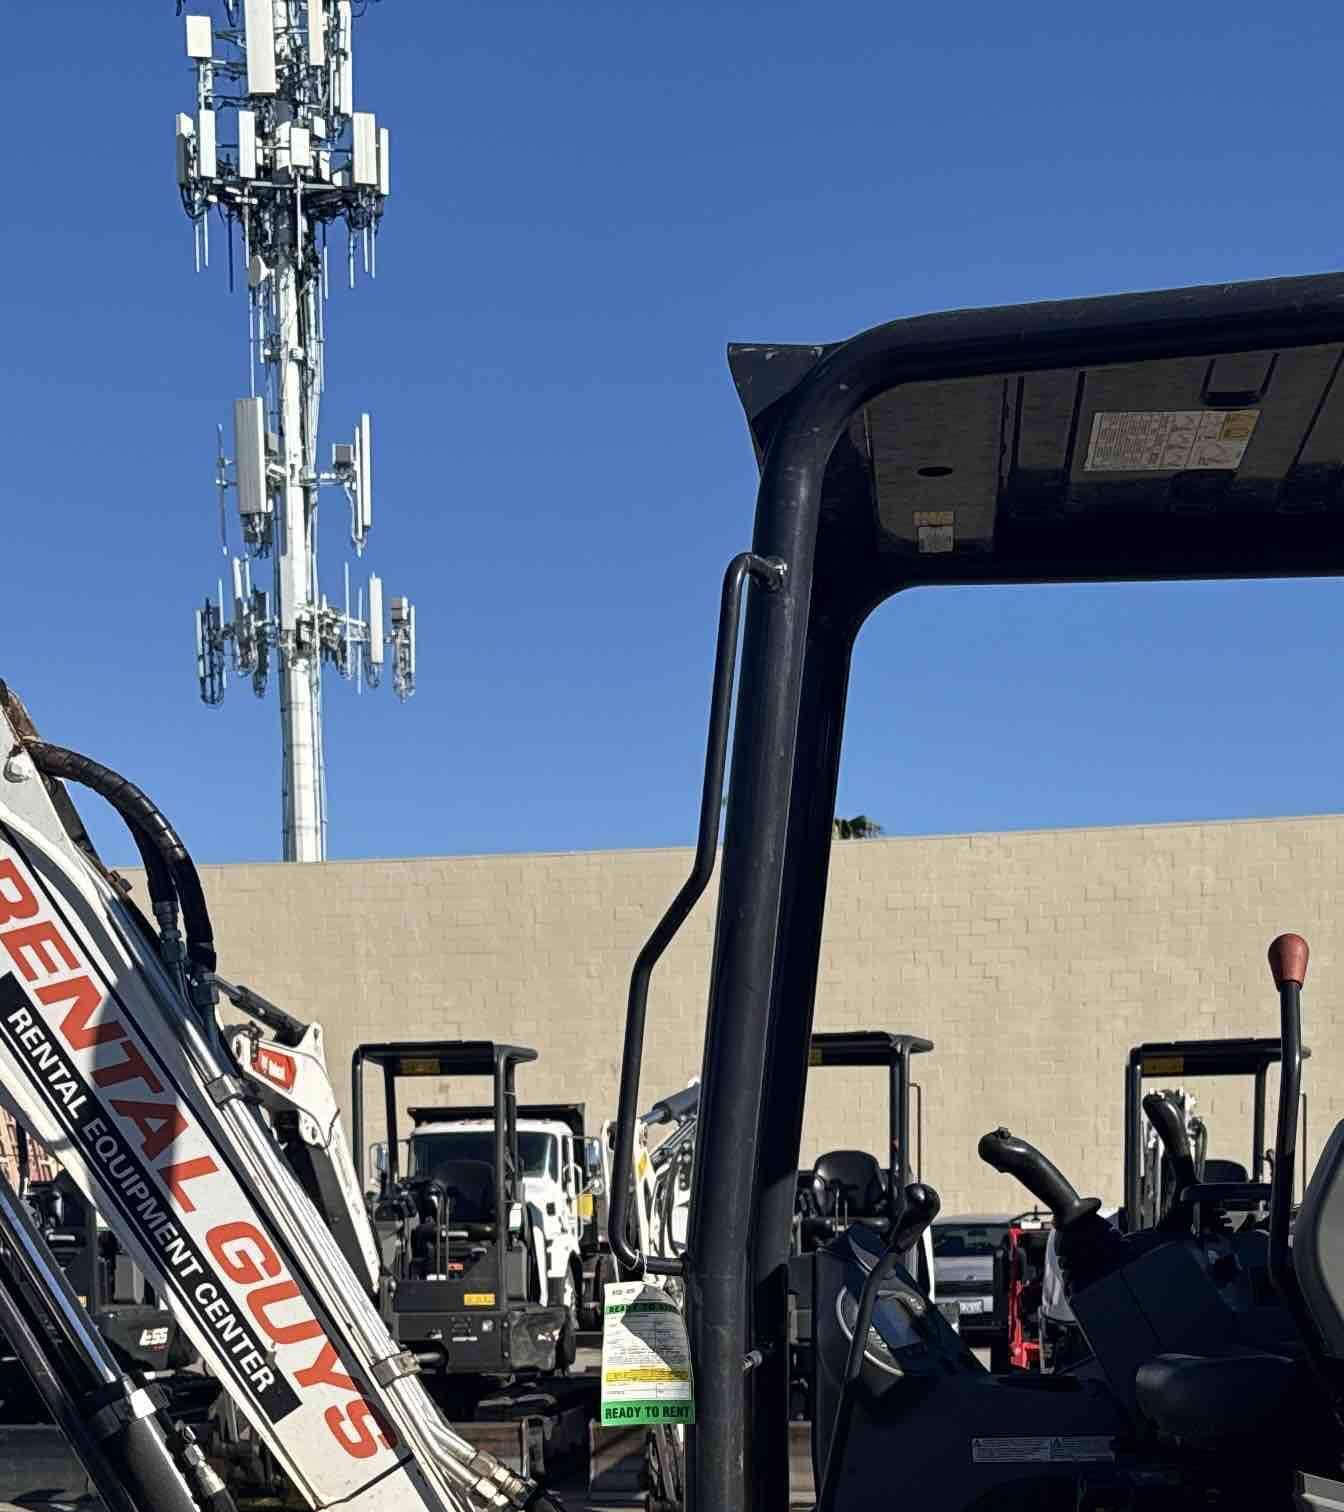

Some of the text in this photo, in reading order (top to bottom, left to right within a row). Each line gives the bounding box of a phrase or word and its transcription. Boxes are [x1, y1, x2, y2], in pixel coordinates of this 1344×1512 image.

[6, 1006, 276, 1394] RENTAL EQUIPMENT CENTER
[205, 1220, 399, 1459] GUYS
[605, 1406, 690, 1420] READY TO RENT
